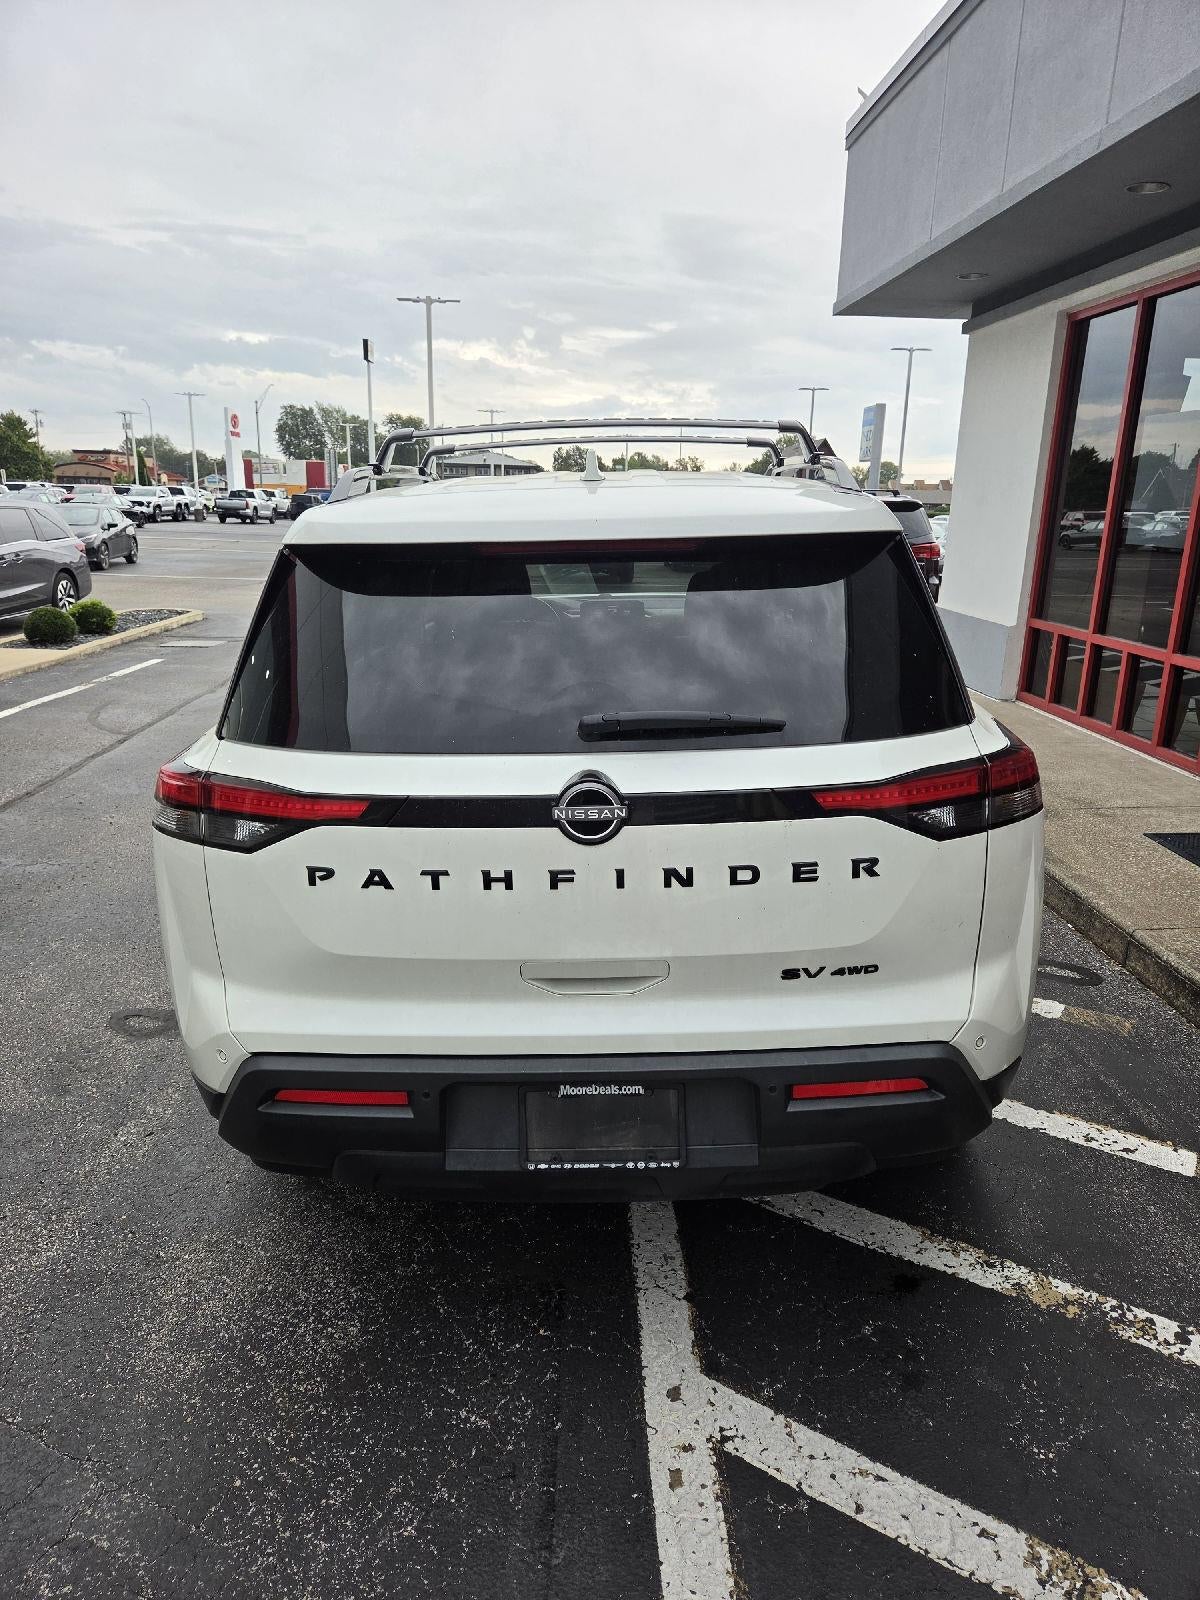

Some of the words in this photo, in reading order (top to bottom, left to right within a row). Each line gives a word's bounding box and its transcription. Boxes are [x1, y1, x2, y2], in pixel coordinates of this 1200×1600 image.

[554, 808, 626, 819] NISSAN
[306, 857, 880, 890] PATHFINDER
[780, 966, 827, 981] SV
[830, 964, 880, 976] 4WD
[558, 1084, 645, 1096] MooreDeals.com
